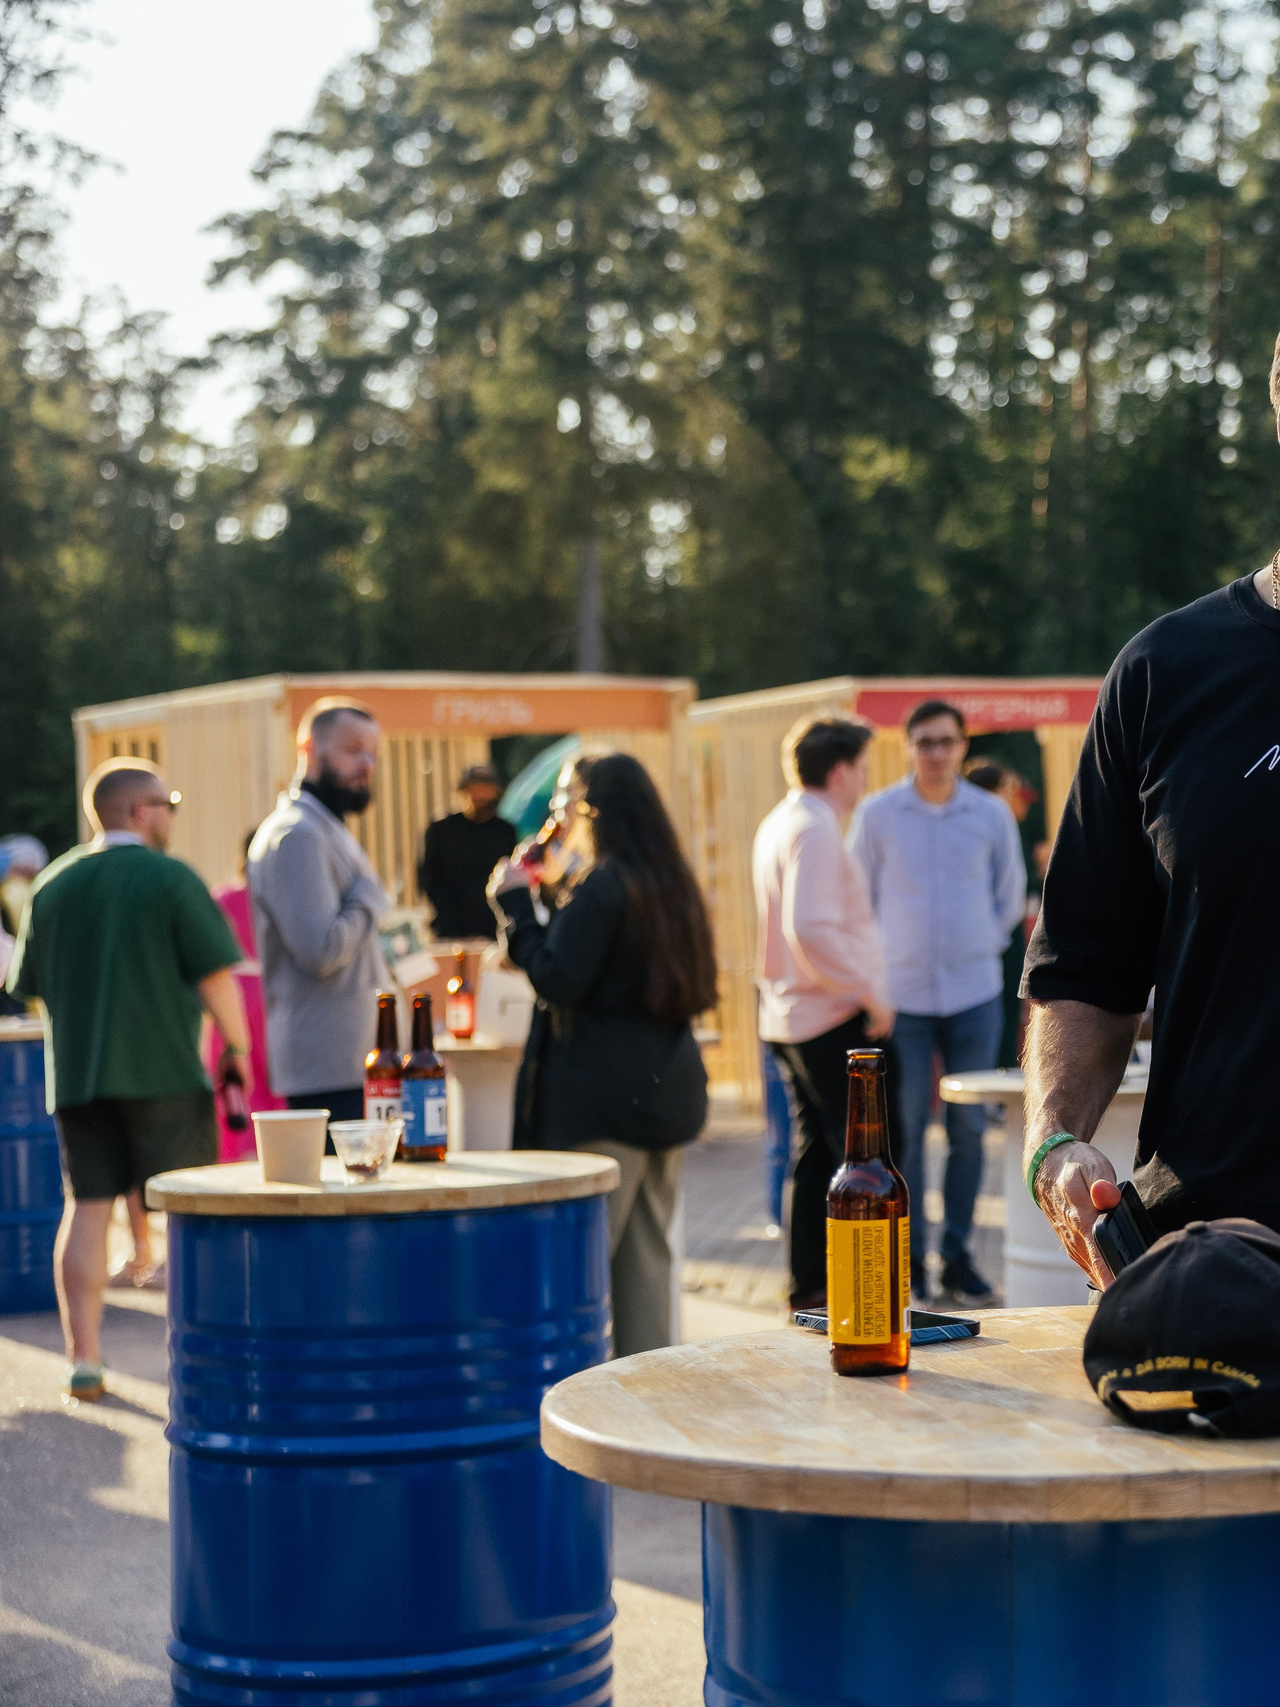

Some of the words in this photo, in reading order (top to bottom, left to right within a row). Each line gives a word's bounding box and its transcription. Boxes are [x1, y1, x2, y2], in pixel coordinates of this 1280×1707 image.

[874, 1225, 886, 1269] ЗДОРОВЬЮ
[875, 1270, 885, 1304] ВАШЕМУ
[875, 1306, 886, 1338] ВРЕДИТ
